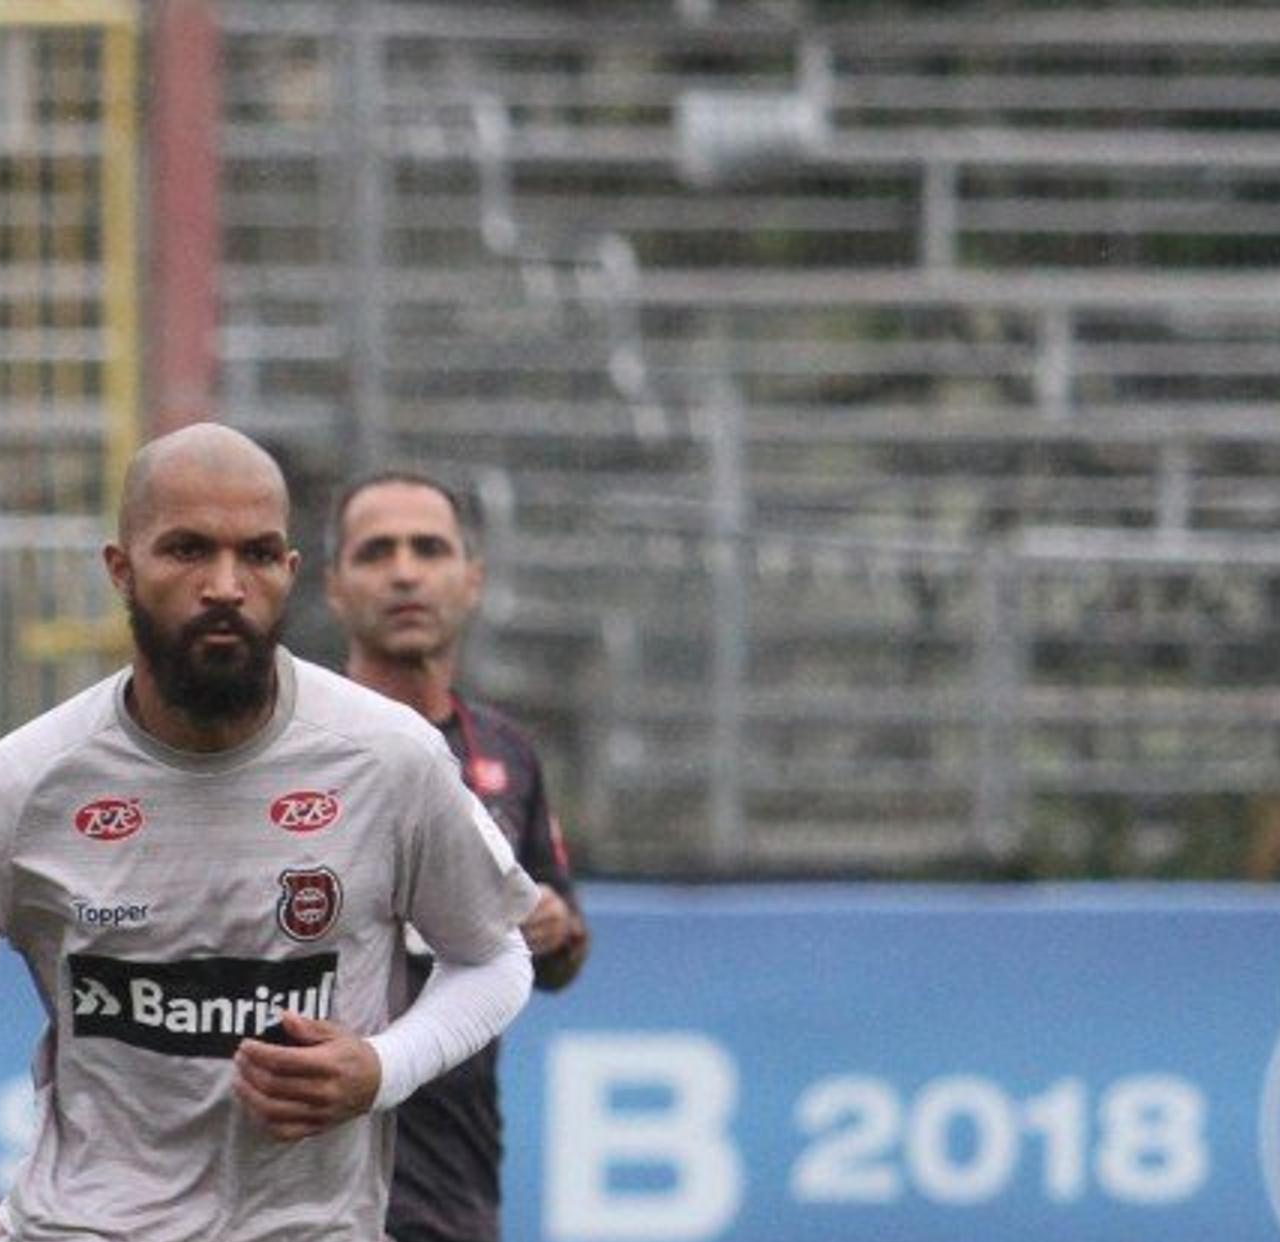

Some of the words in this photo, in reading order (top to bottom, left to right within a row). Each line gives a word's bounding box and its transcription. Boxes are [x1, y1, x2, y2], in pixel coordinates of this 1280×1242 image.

[74, 903, 148, 925] Topper
[129, 971, 335, 1036] Banrisul
[790, 1074, 1210, 1204] 2018
